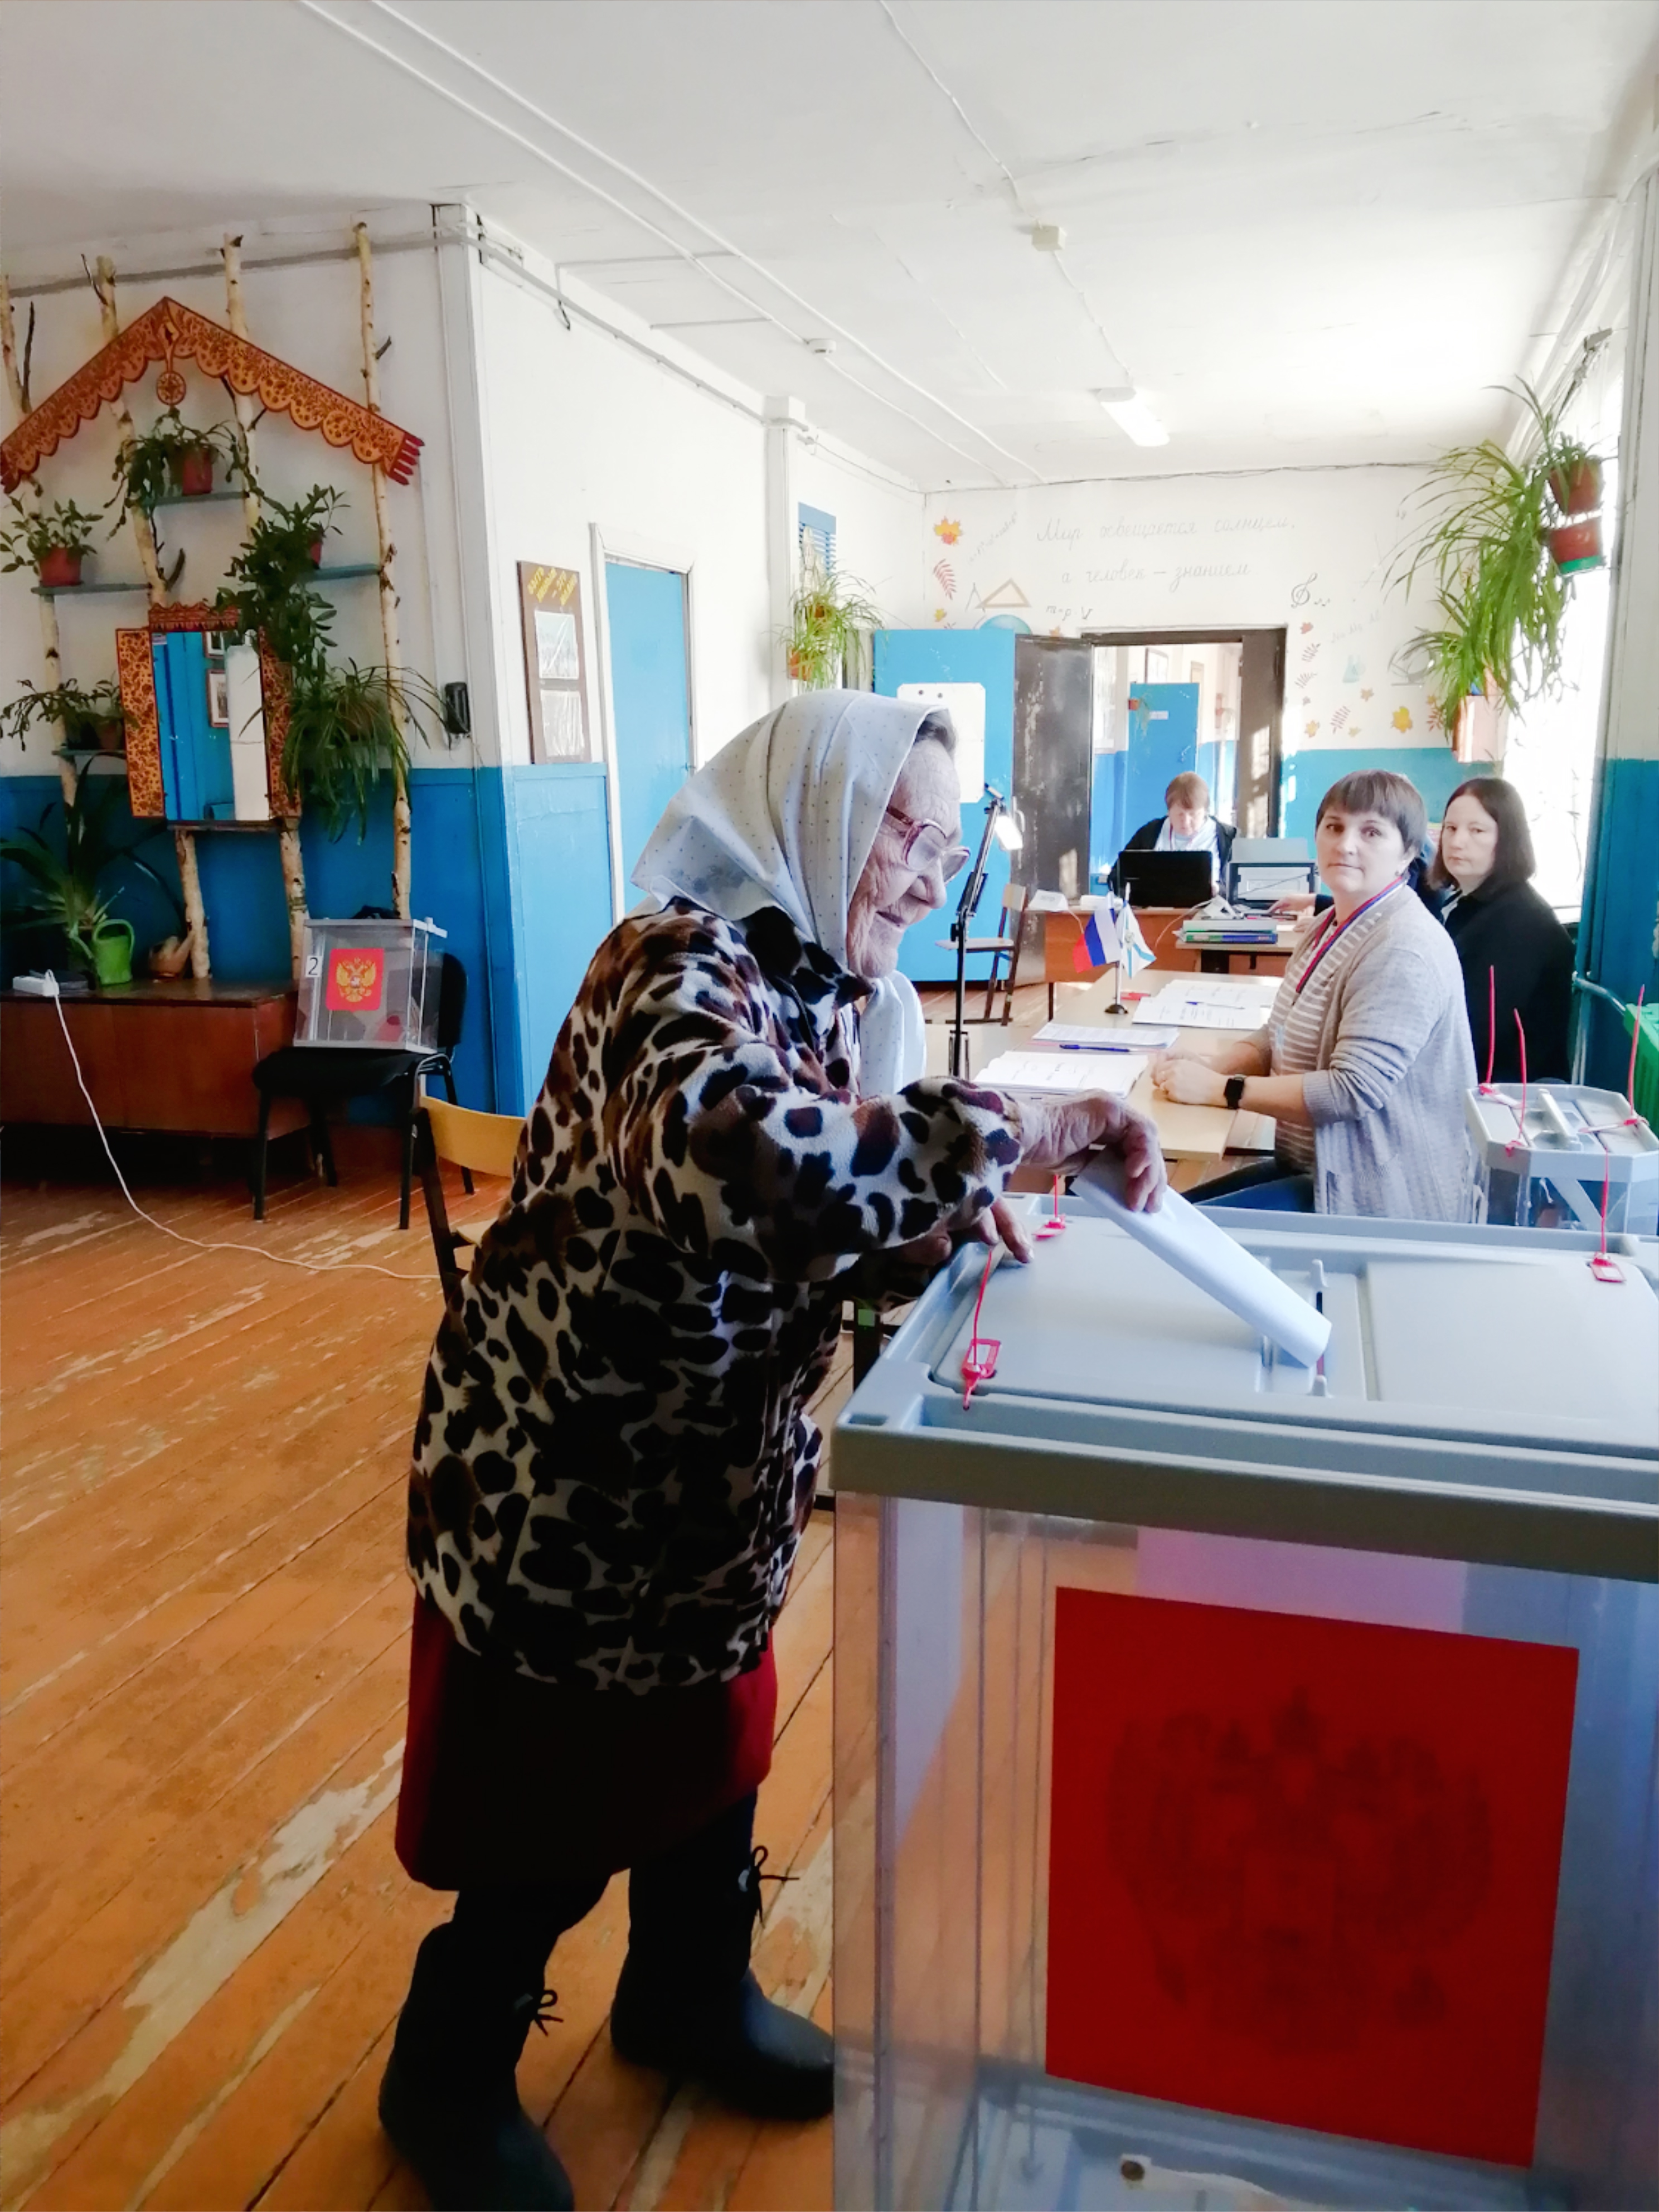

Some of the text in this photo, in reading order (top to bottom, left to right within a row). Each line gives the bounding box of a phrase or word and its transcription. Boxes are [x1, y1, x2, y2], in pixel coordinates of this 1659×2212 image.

[1036, 517, 1083, 551] Мир
[1099, 515, 1197, 539] освещается
[1061, 570, 1072, 584] а
[1086, 557, 1147, 583] человек
[308, 957, 318, 976] 2
